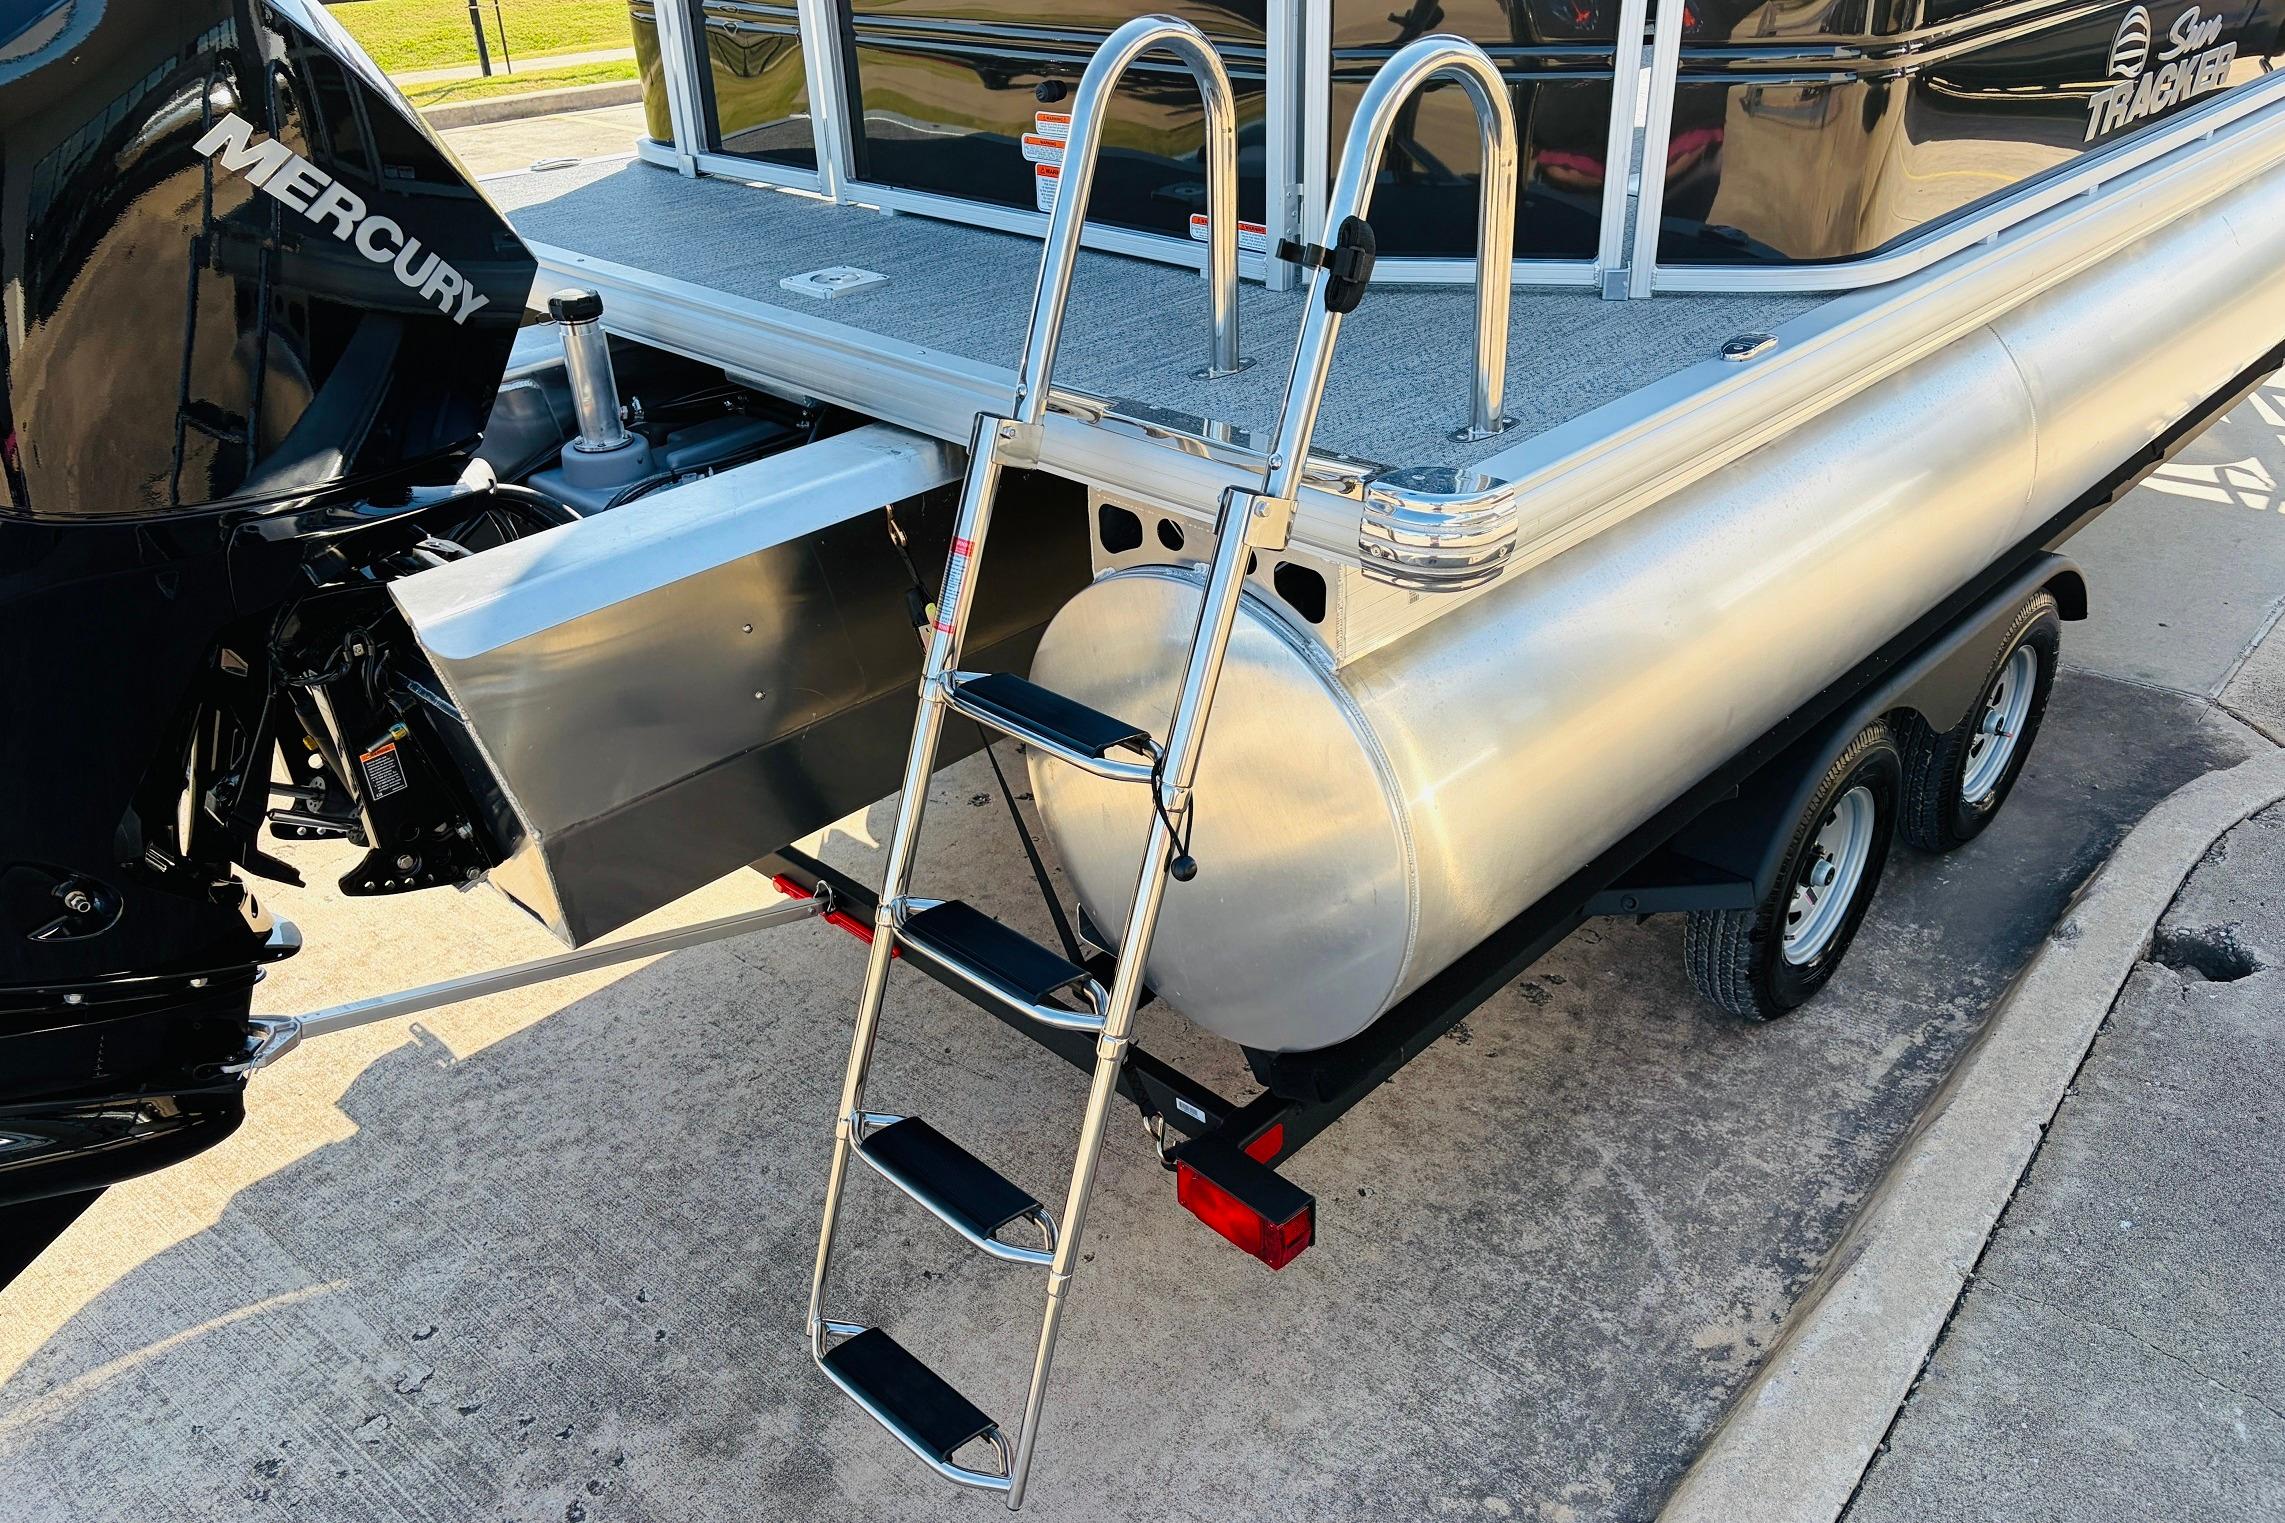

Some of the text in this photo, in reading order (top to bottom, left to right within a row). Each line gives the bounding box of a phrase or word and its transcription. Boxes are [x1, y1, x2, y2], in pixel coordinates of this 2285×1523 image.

[2158, 5, 2223, 61] Sun
[2083, 41, 2238, 143] TRACKER
[192, 112, 490, 325] MERCURY
